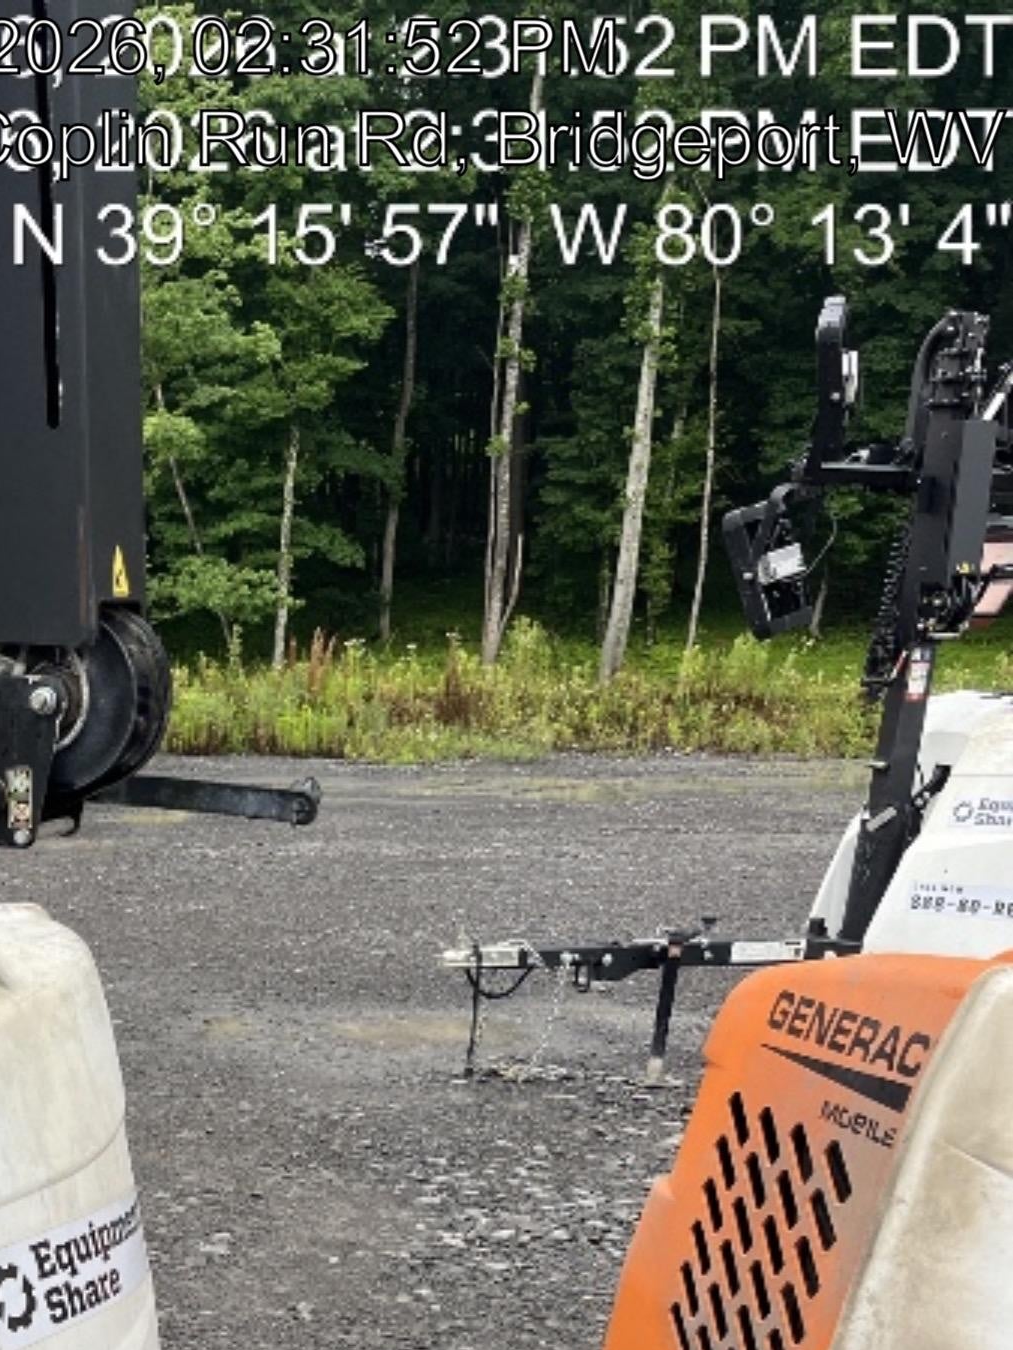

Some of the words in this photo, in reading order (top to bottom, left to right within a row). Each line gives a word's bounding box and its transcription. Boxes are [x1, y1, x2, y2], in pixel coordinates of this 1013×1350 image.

[767, 989, 931, 1079] GENERAC
[820, 1100, 898, 1149] MOBILE
[44, 1267, 124, 1325] Share
